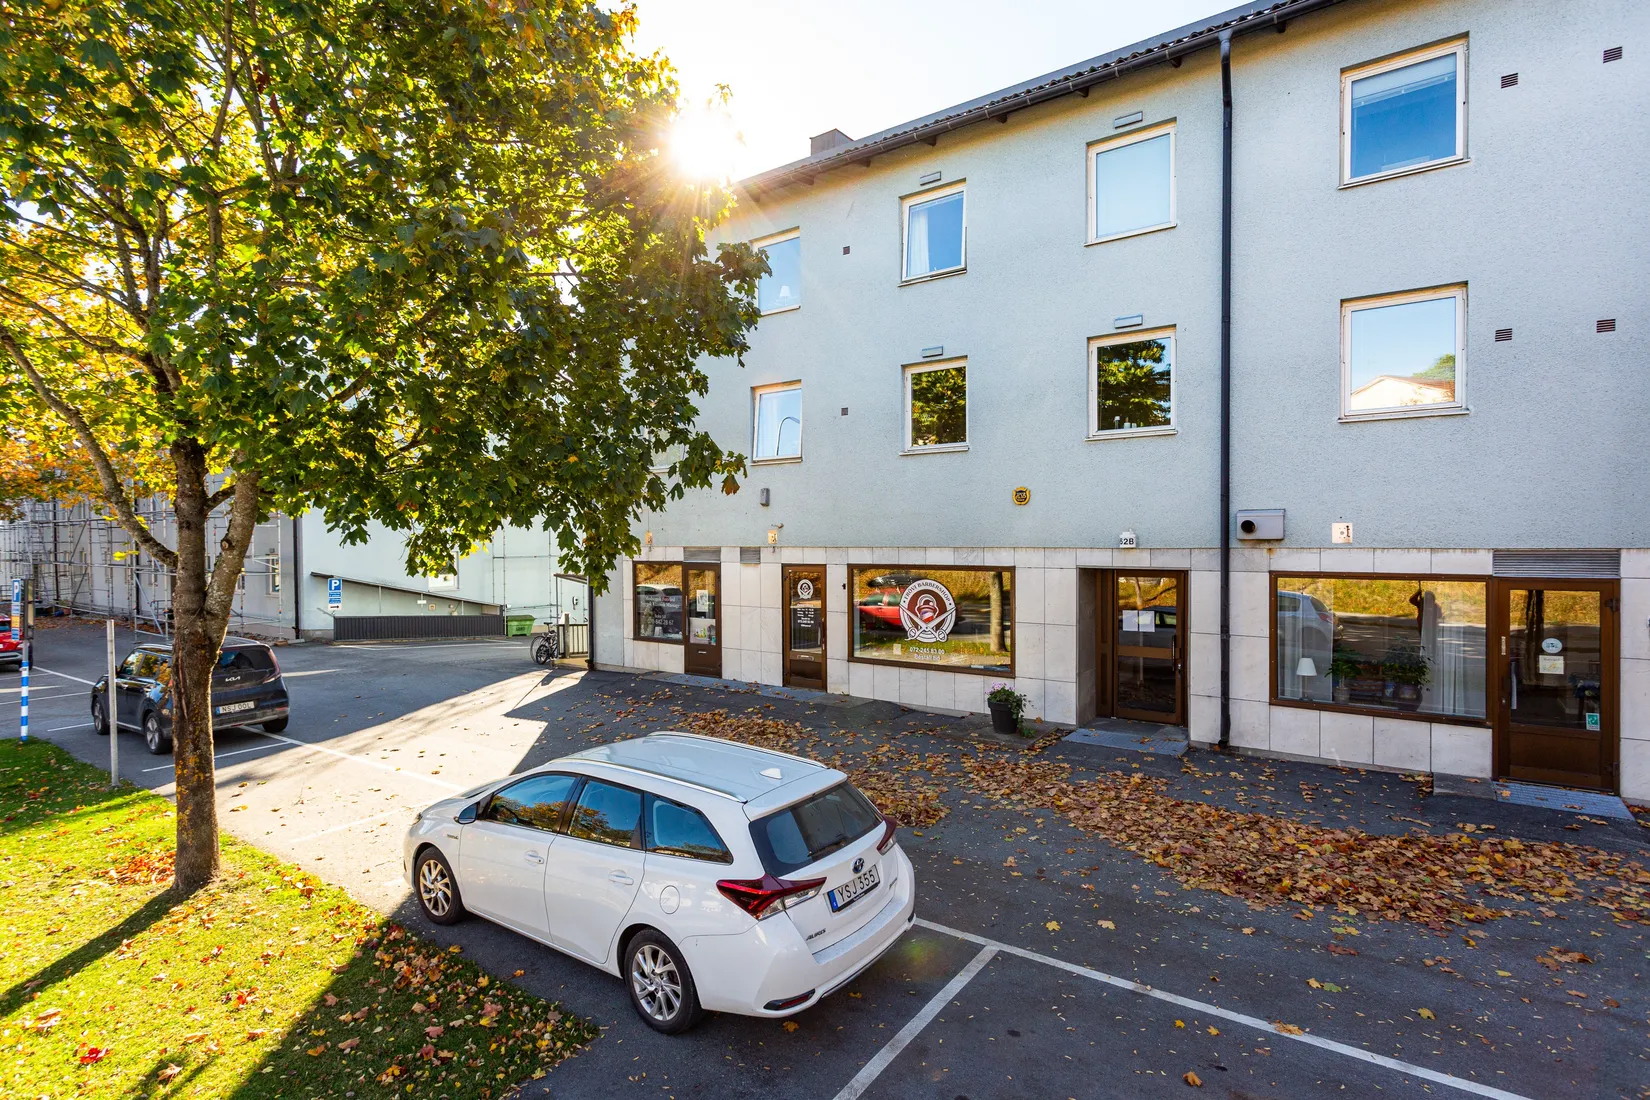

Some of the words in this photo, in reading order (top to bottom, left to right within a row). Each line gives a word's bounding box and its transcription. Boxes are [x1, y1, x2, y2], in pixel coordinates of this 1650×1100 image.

[331, 580, 340, 591] P
[917, 582, 950, 601] BARBERSHOP
[838, 880, 857, 902] YSJ
[858, 869, 876, 890] 355
[806, 928, 826, 941] AURIS
